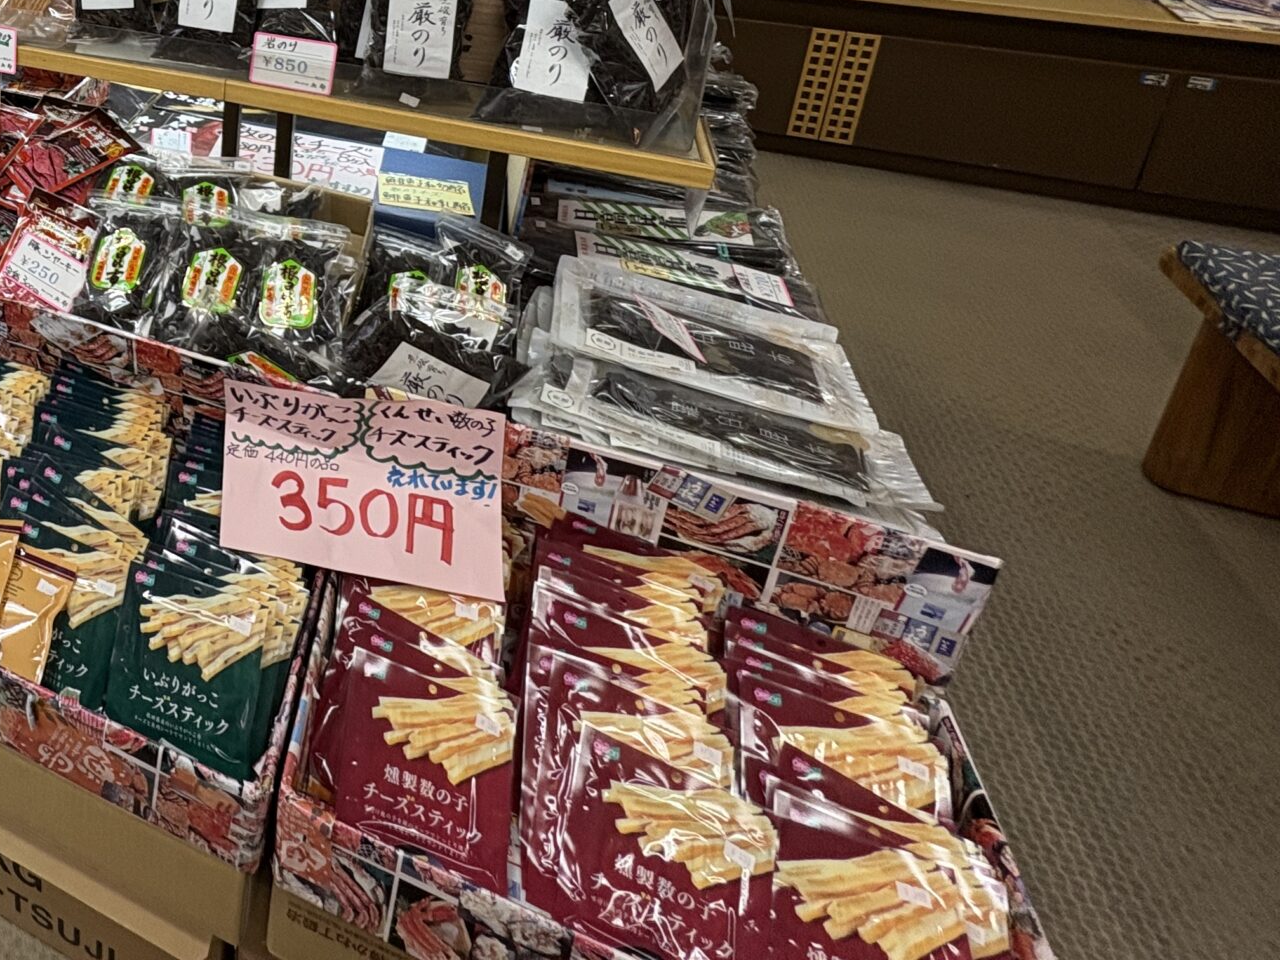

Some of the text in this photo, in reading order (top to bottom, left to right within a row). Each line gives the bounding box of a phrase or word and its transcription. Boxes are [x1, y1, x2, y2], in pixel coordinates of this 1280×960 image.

[262, 36, 299, 52] 岩のり
[408, 0, 438, 69] 厳のり
[631, 1, 668, 64] 厳のり
[262, 54, 308, 75] ¥850
[19, 257, 60, 285] ¥250
[230, 385, 354, 425] いぶりがっこ
[226, 443, 340, 472] 定価 440円の品
[230, 408, 496, 467] チーズスティック チーズスティック
[271, 470, 455, 567] 350円
[128, 683, 230, 736] チーズスティック
[142, 666, 221, 709] いぶりがっこ
[383, 764, 470, 812] 燻製数の子
[363, 783, 482, 844] チーズスティック
[614, 853, 726, 921] 燻製数の子
